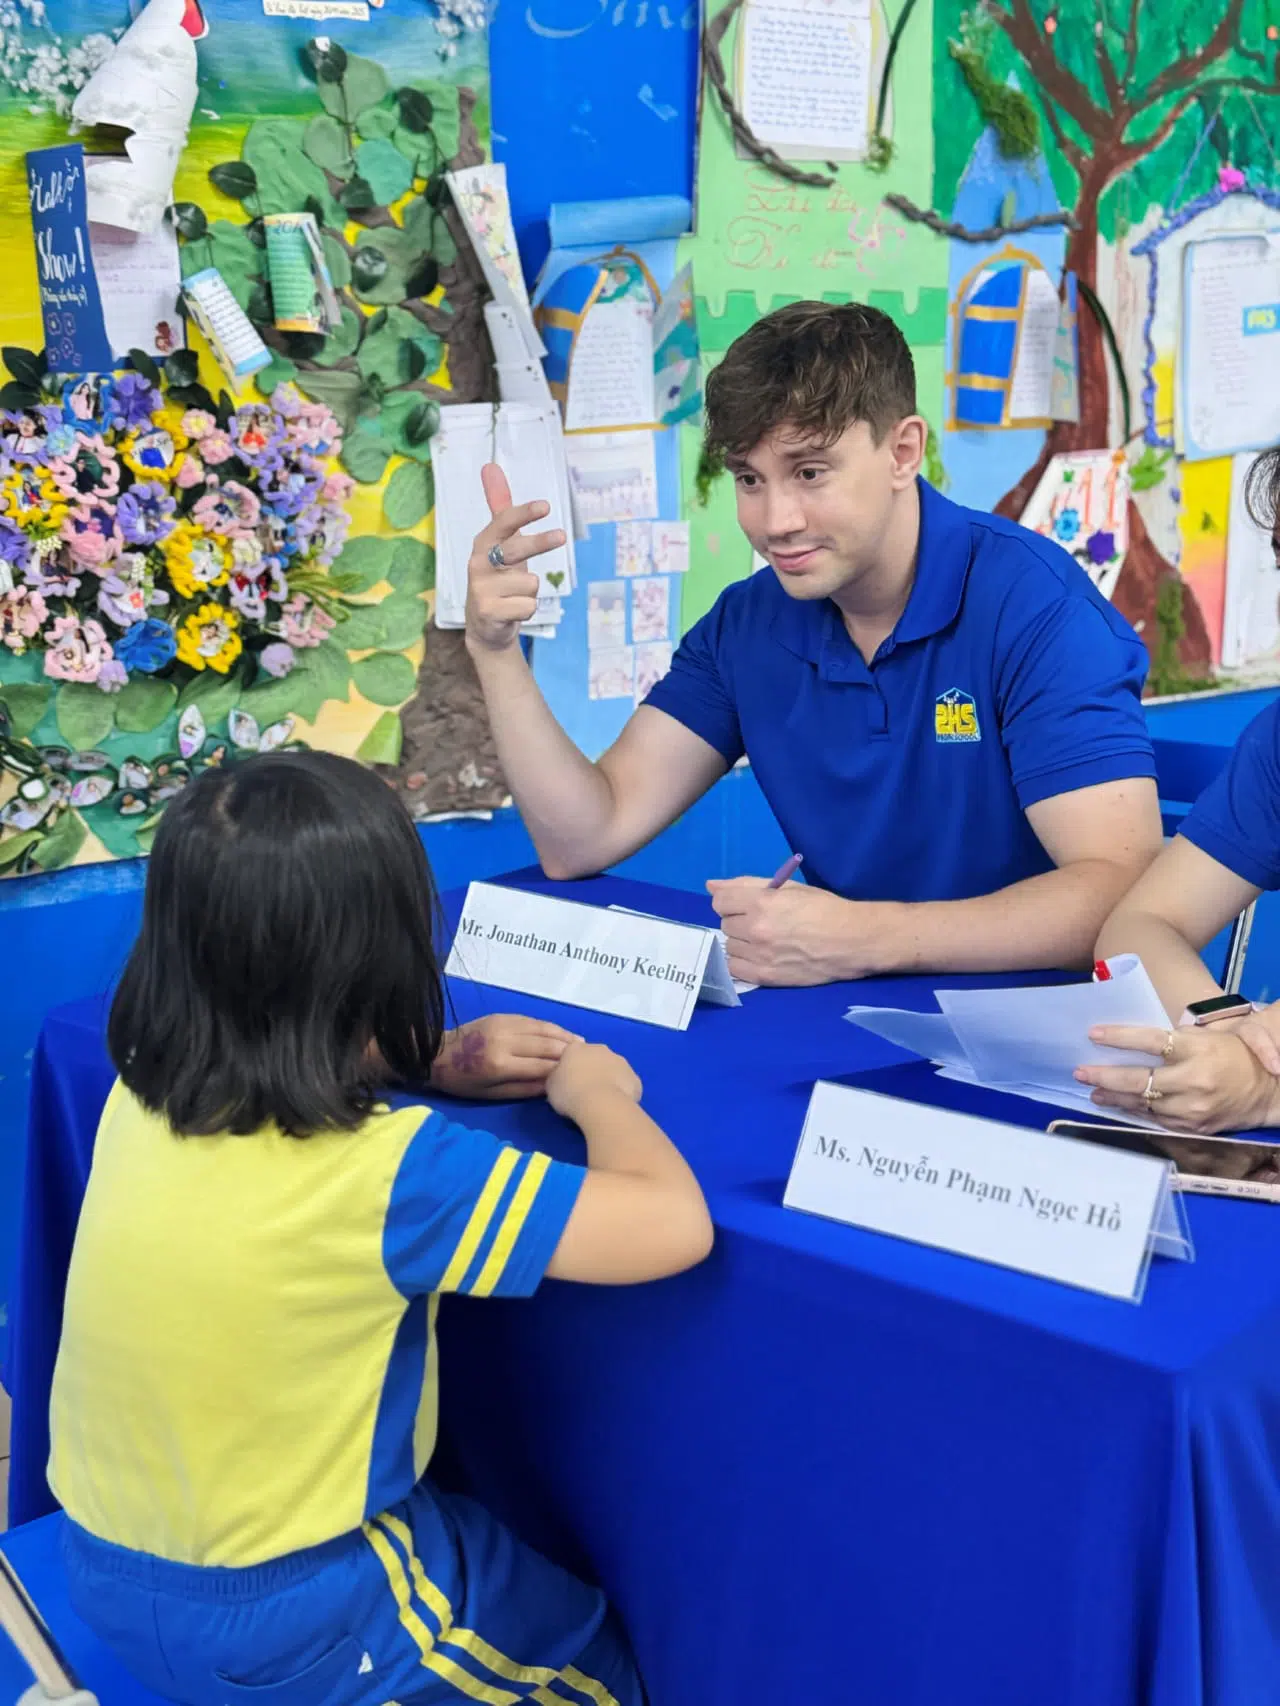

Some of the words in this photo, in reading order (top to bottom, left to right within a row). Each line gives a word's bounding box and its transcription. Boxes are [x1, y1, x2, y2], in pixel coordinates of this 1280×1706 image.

[462, 918, 483, 938] Mr.
[486, 924, 557, 955] Jonathan
[558, 941, 630, 975] Anthony
[632, 956, 697, 991] Keeling
[814, 1136, 851, 1163] Ms.
[857, 1146, 939, 1186] Nguyễn
[944, 1168, 1012, 1204] Phạm
[1017, 1186, 1079, 1223] Ngọc
[1085, 1202, 1122, 1232] Hồ
